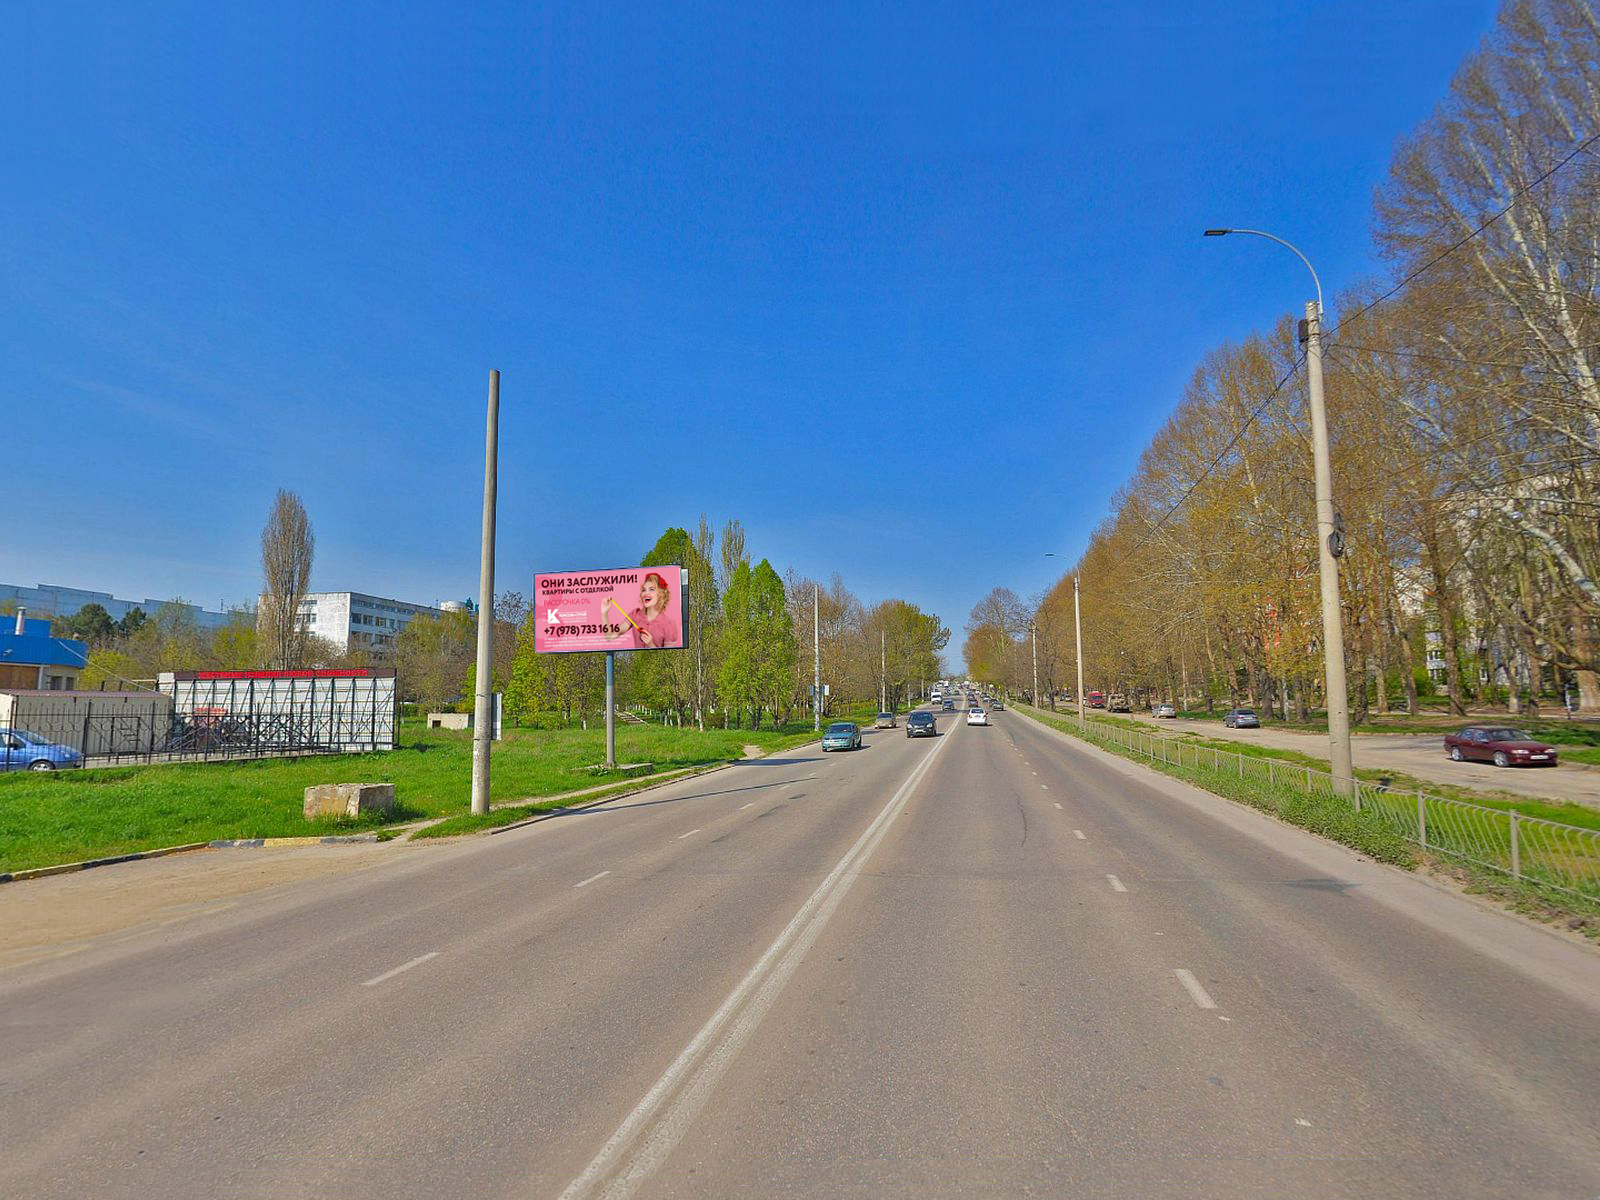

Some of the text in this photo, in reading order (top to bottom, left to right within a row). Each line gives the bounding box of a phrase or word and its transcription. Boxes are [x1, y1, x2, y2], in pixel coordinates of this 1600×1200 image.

[541, 574, 638, 588] ОНИ ЗАСЛУЖИЛИ!
[580, 585, 614, 594] ОТДЕЛКОЙ
[544, 623, 620, 637] +7 (978) 733 16 16
